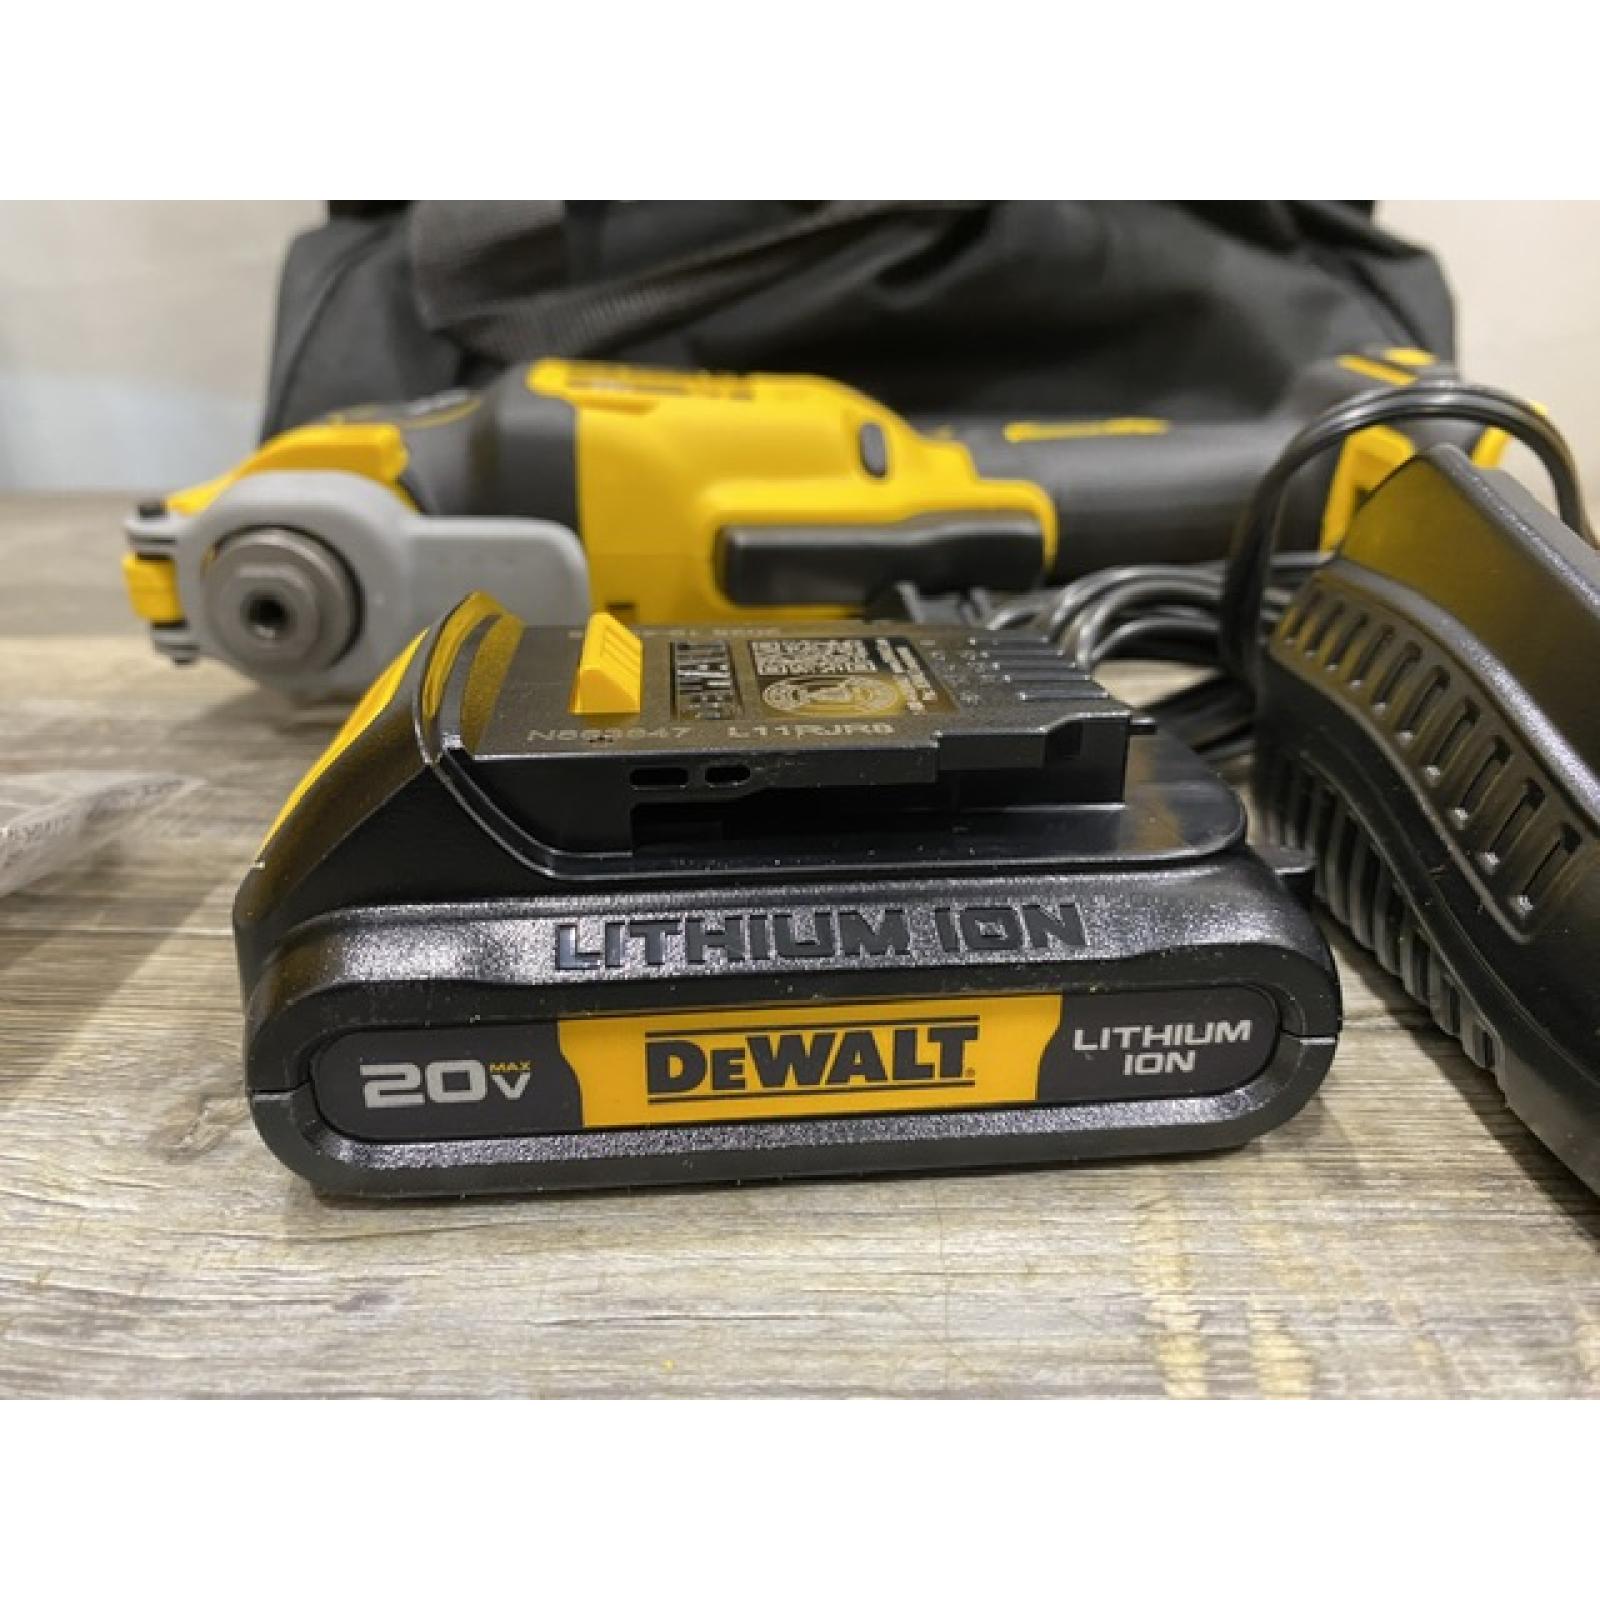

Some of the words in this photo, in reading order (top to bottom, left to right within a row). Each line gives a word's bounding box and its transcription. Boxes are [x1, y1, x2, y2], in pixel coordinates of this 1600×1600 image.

[556, 910, 911, 970] LITHIUM
[935, 903, 1087, 952] ION
[1073, 1018, 1252, 1052] LITHIUM
[489, 1060, 532, 1073] MAX
[1122, 1049, 1197, 1077] ION
